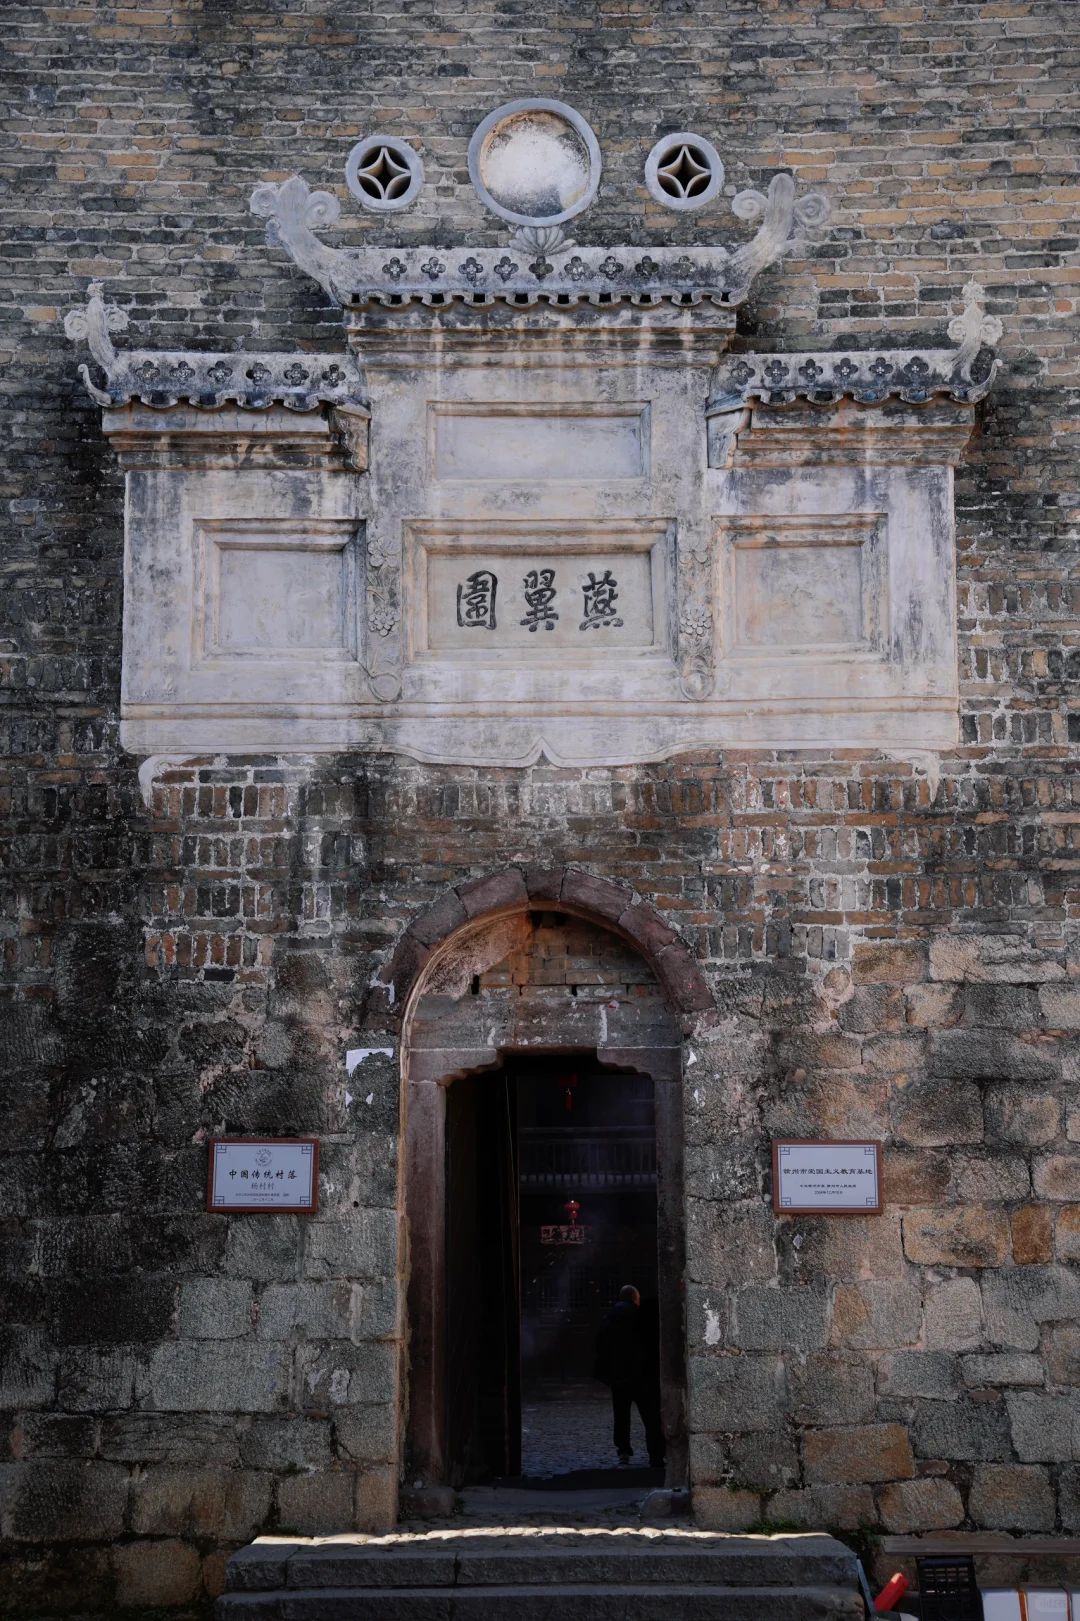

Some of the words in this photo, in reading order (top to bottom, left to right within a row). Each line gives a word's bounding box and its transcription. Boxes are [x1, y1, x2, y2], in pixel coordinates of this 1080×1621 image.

[229, 1169, 297, 1180] 中国传统村落
